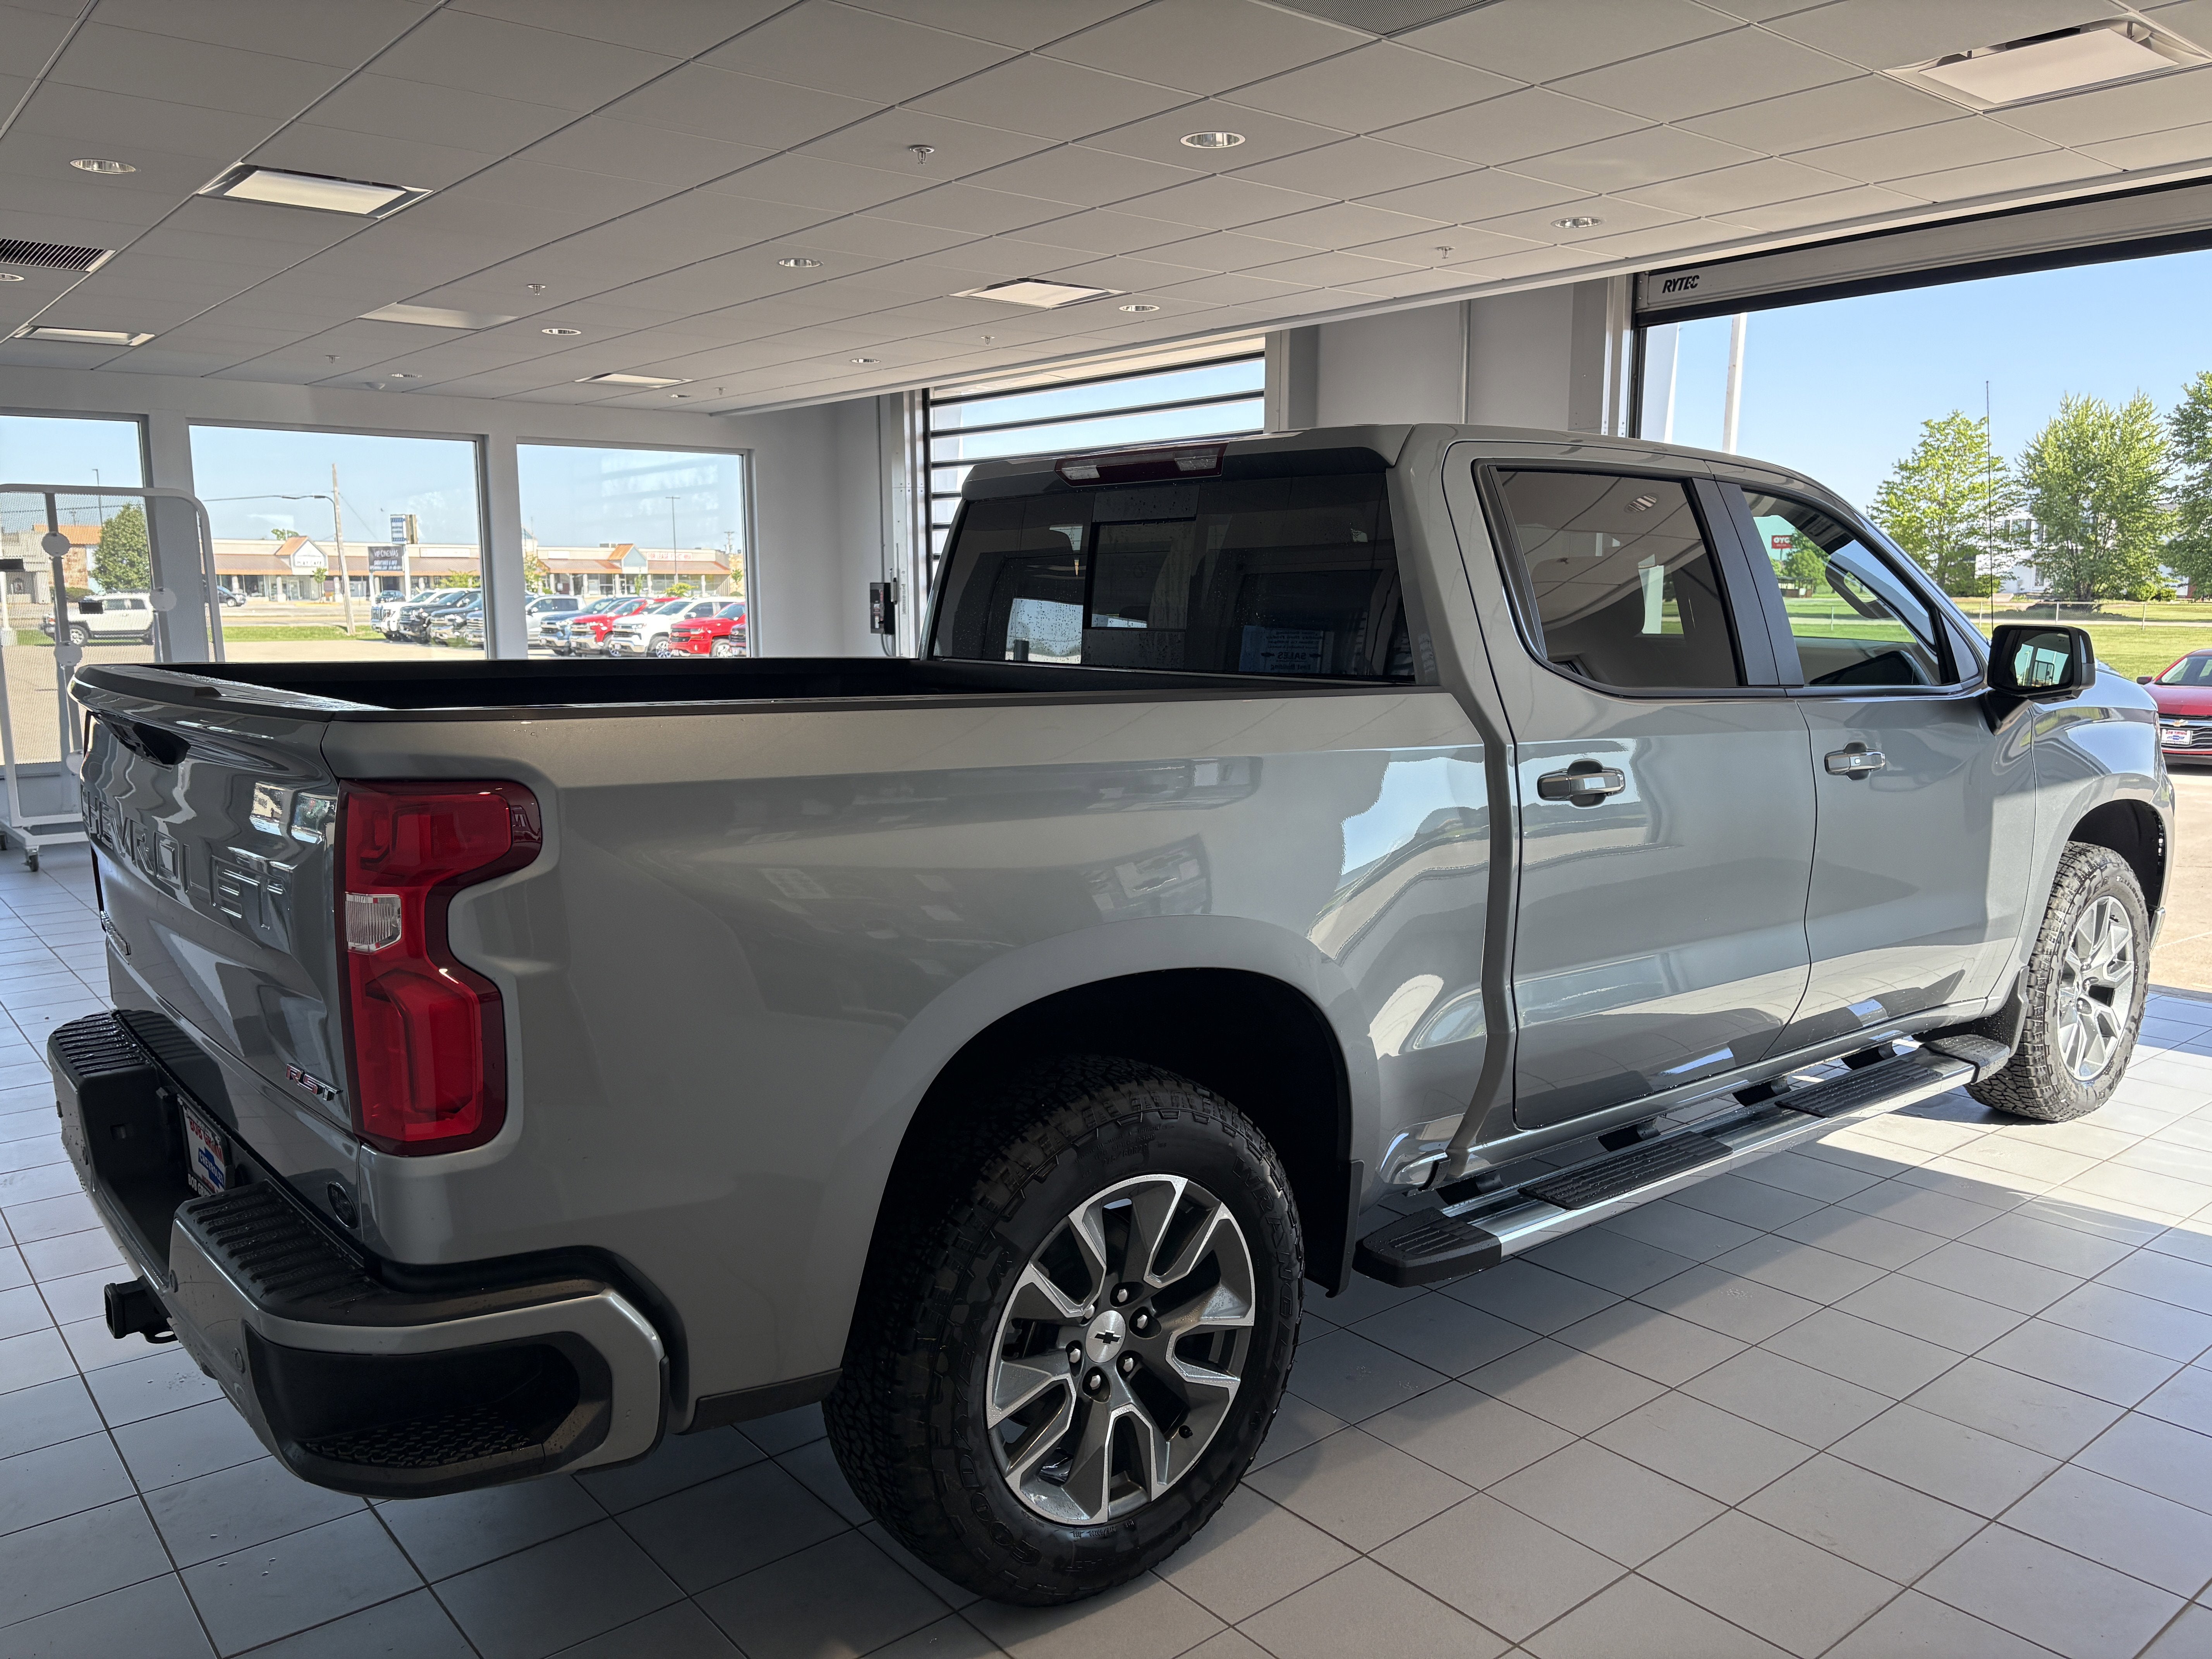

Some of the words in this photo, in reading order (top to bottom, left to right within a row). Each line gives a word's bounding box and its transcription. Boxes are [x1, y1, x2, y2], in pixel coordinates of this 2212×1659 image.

[1662, 275, 1700, 294] RYTEC
[285, 1062, 344, 1101] RST
[189, 1118, 203, 1140] BOB
[198, 1151, 224, 1185] CHEVROLET
[188, 1173, 198, 1192] BOB
[954, 1250, 1042, 1566] GOODYEAR
